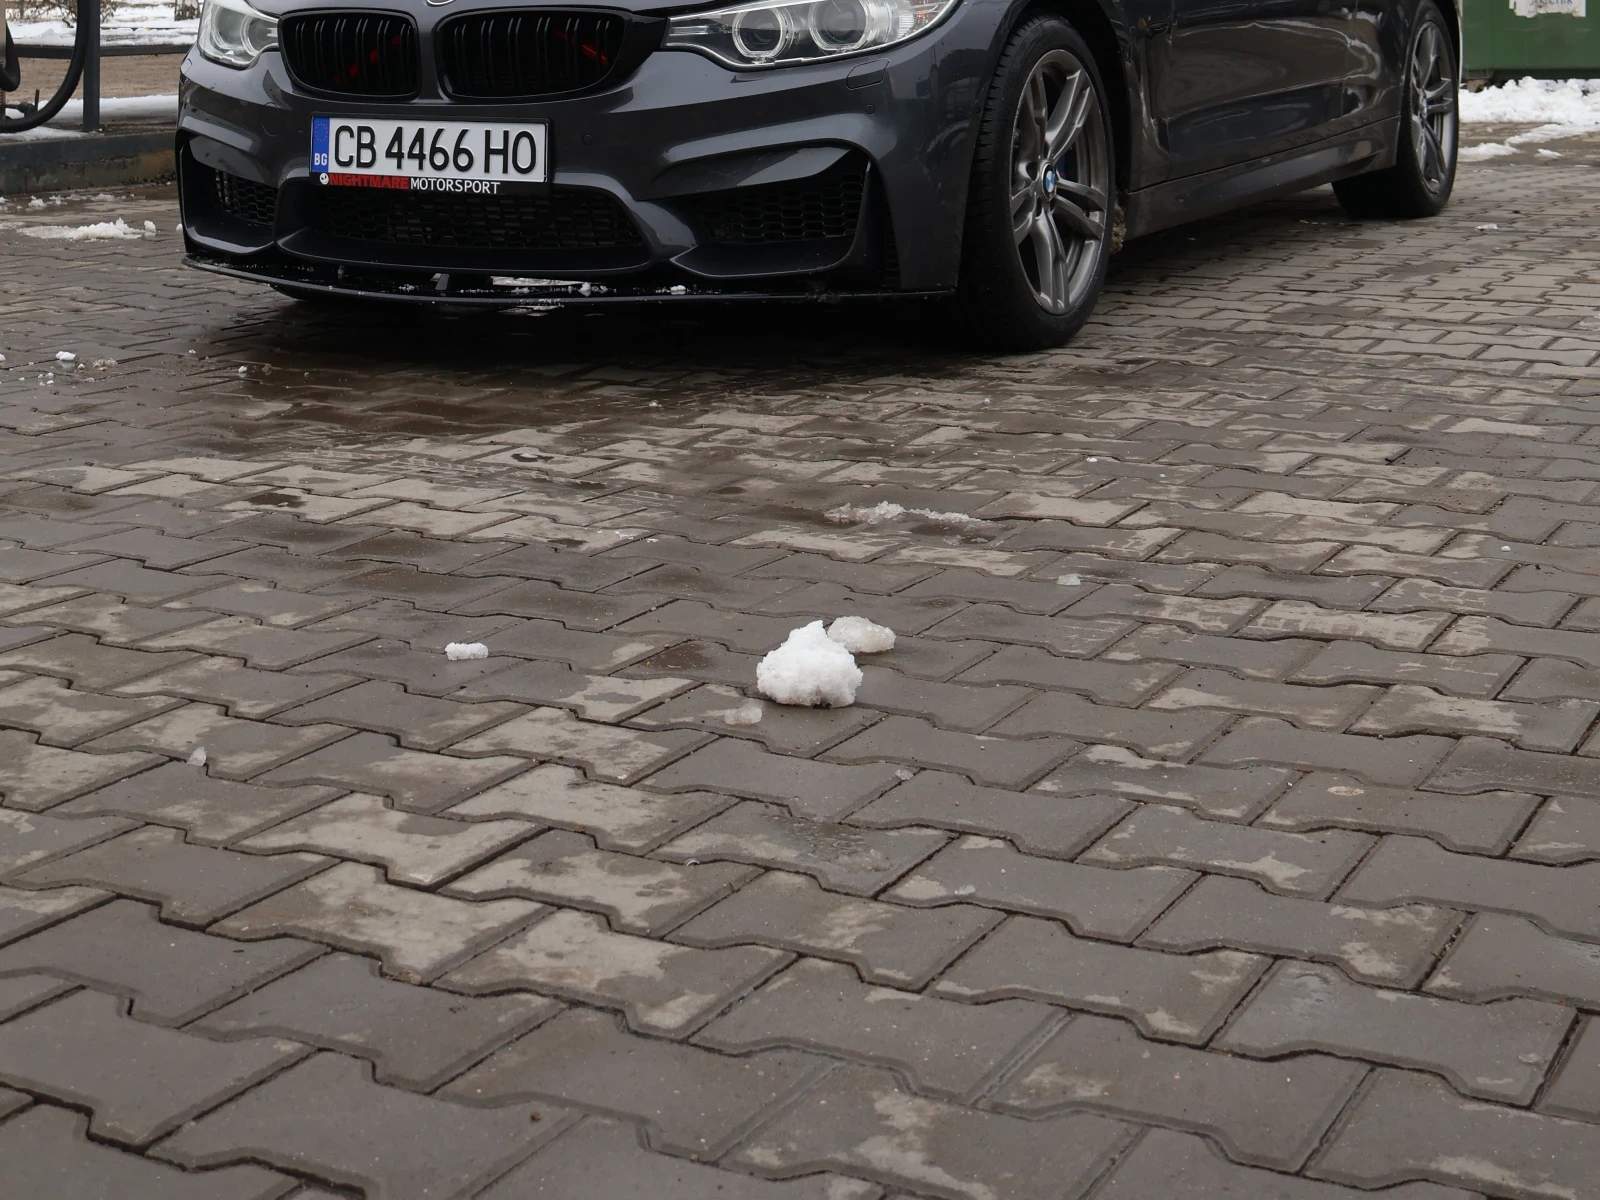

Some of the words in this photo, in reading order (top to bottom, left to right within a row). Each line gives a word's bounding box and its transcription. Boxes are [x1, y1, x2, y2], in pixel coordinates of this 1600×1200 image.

[314, 152, 328, 166] BG
[334, 125, 377, 169] CB
[385, 126, 474, 172] 4466
[484, 129, 537, 175] HO
[329, 173, 408, 189] NIGHTMARE
[411, 177, 500, 194] MOTORSPORT
